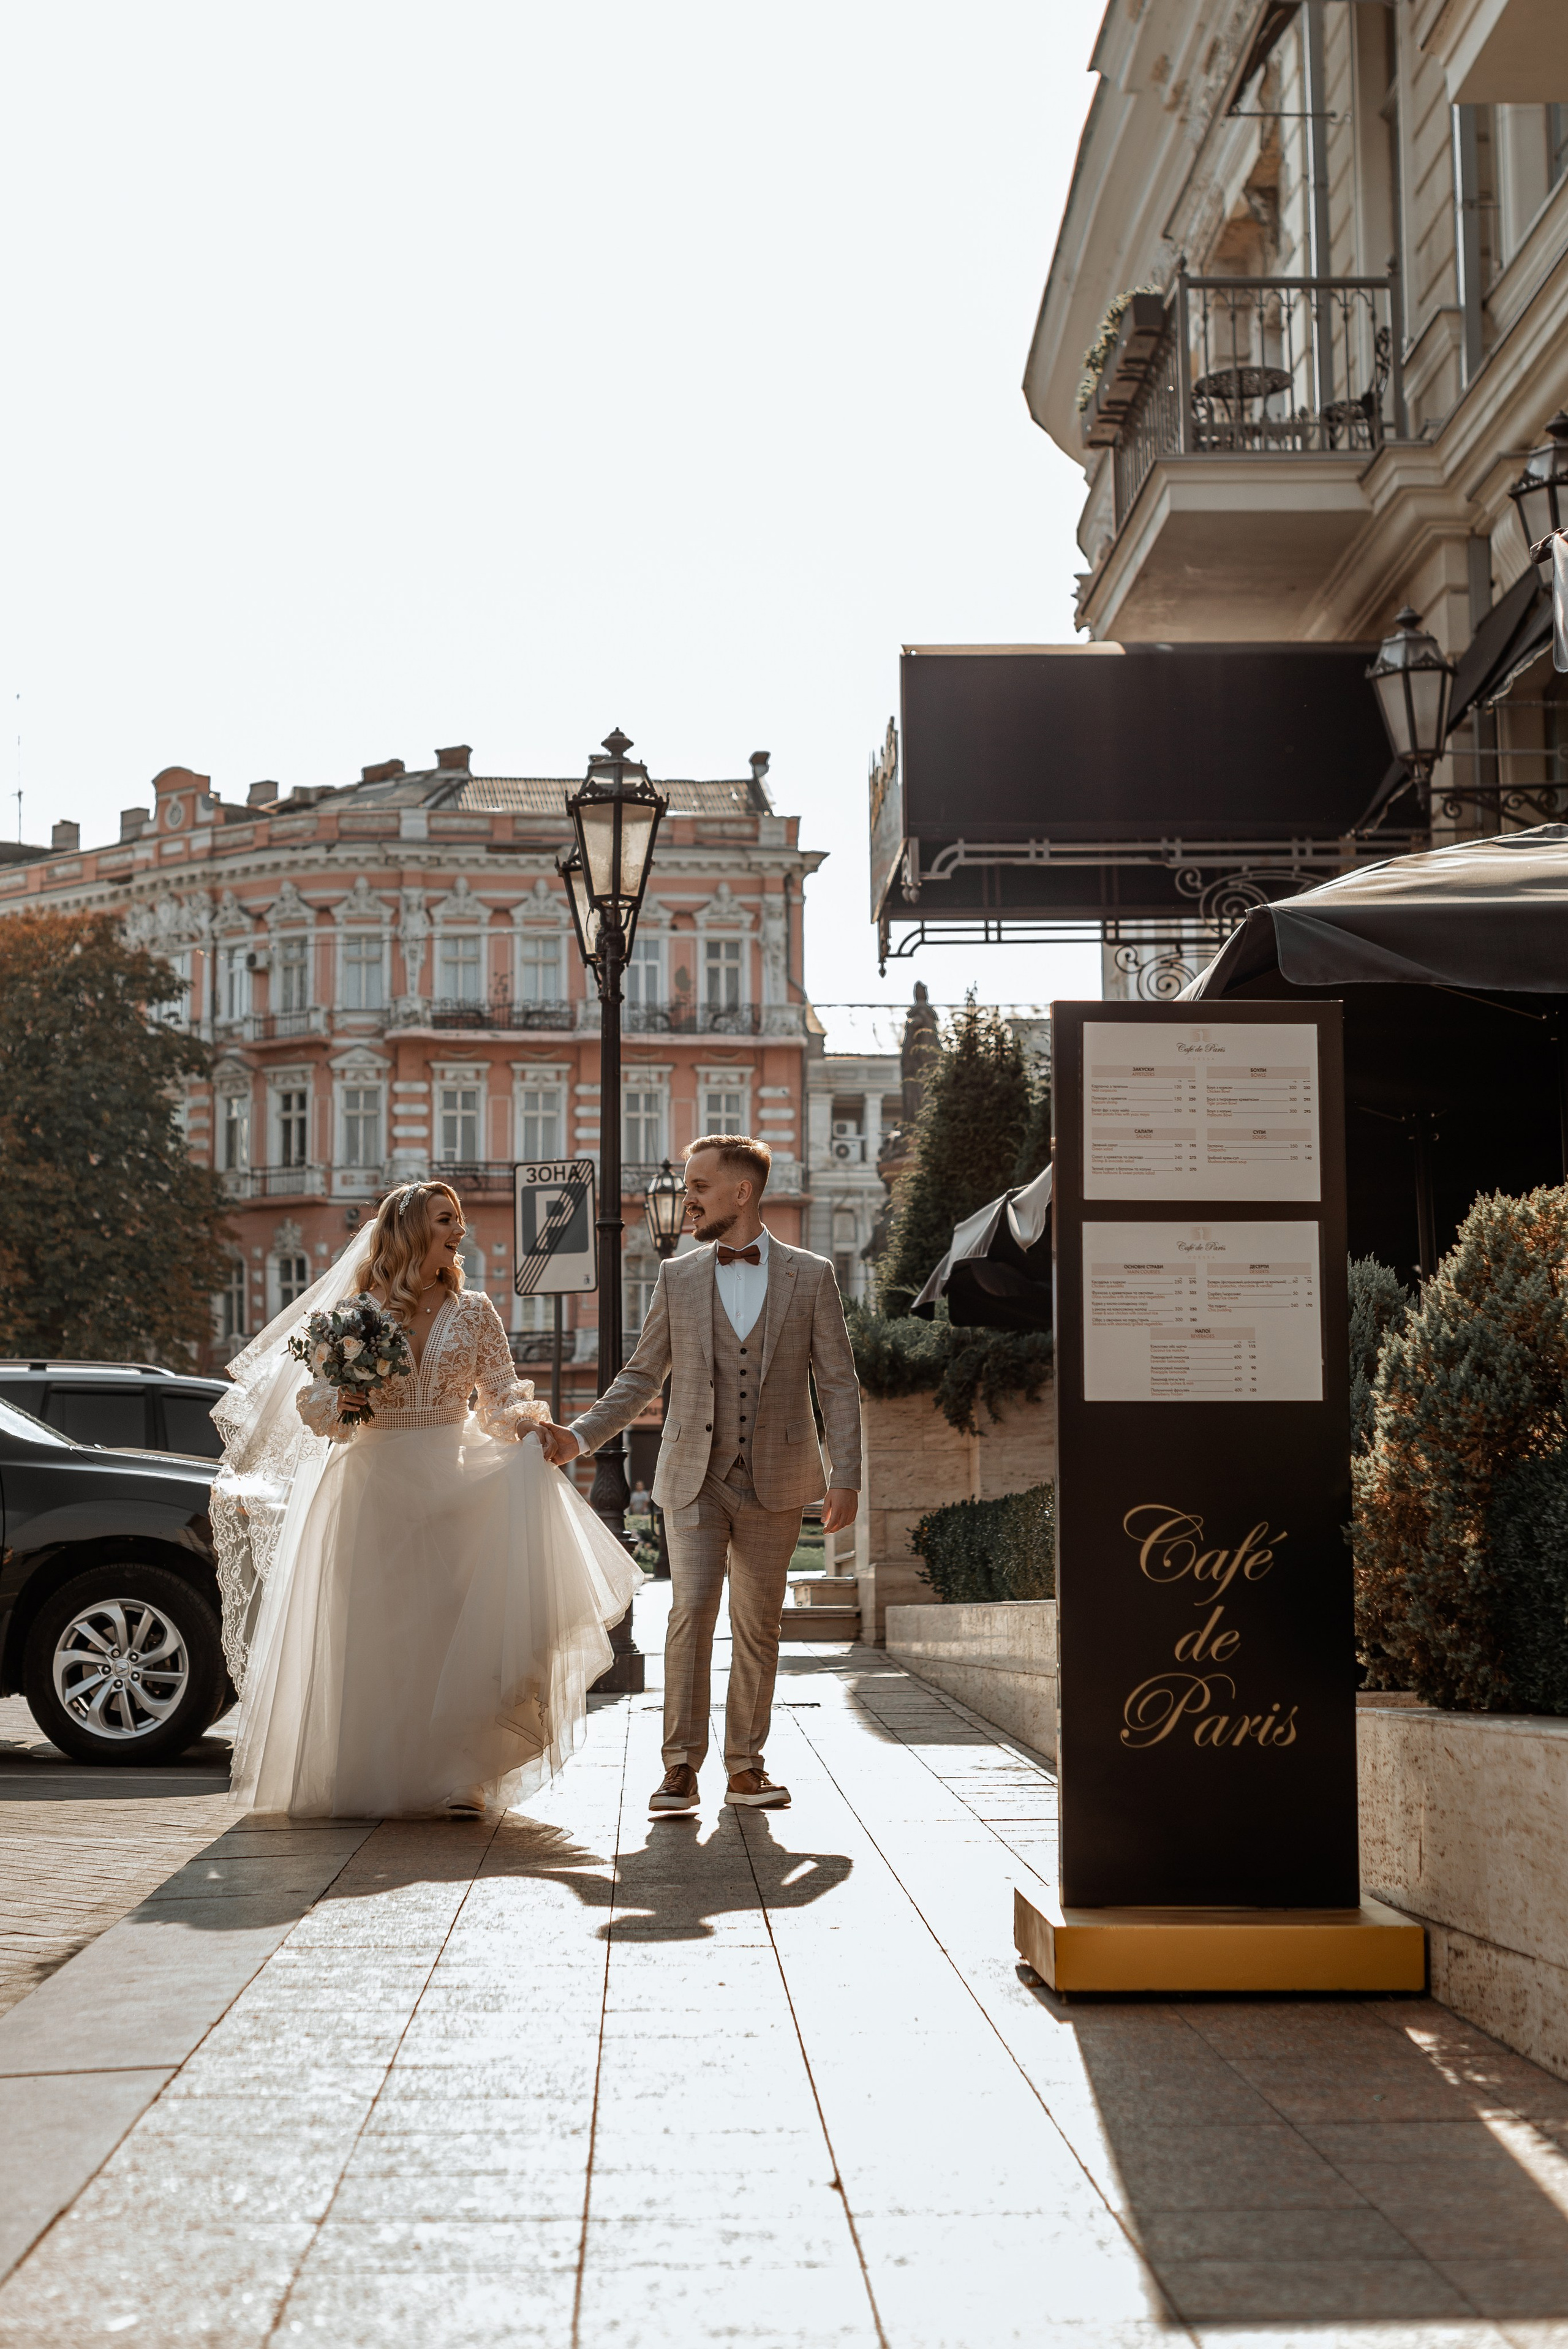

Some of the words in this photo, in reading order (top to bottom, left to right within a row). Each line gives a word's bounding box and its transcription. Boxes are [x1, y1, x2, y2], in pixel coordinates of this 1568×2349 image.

[1176, 1043, 1196, 1055] Café
[1205, 1043, 1226, 1052] Paris
[526, 1165, 580, 1183] ЗОНА
[1177, 1241, 1196, 1253] Café
[1205, 1242, 1226, 1251] Paris
[1123, 1504, 1287, 1606] Café
[1175, 1605, 1241, 1662] de
[1120, 1673, 1298, 1748] Paris
